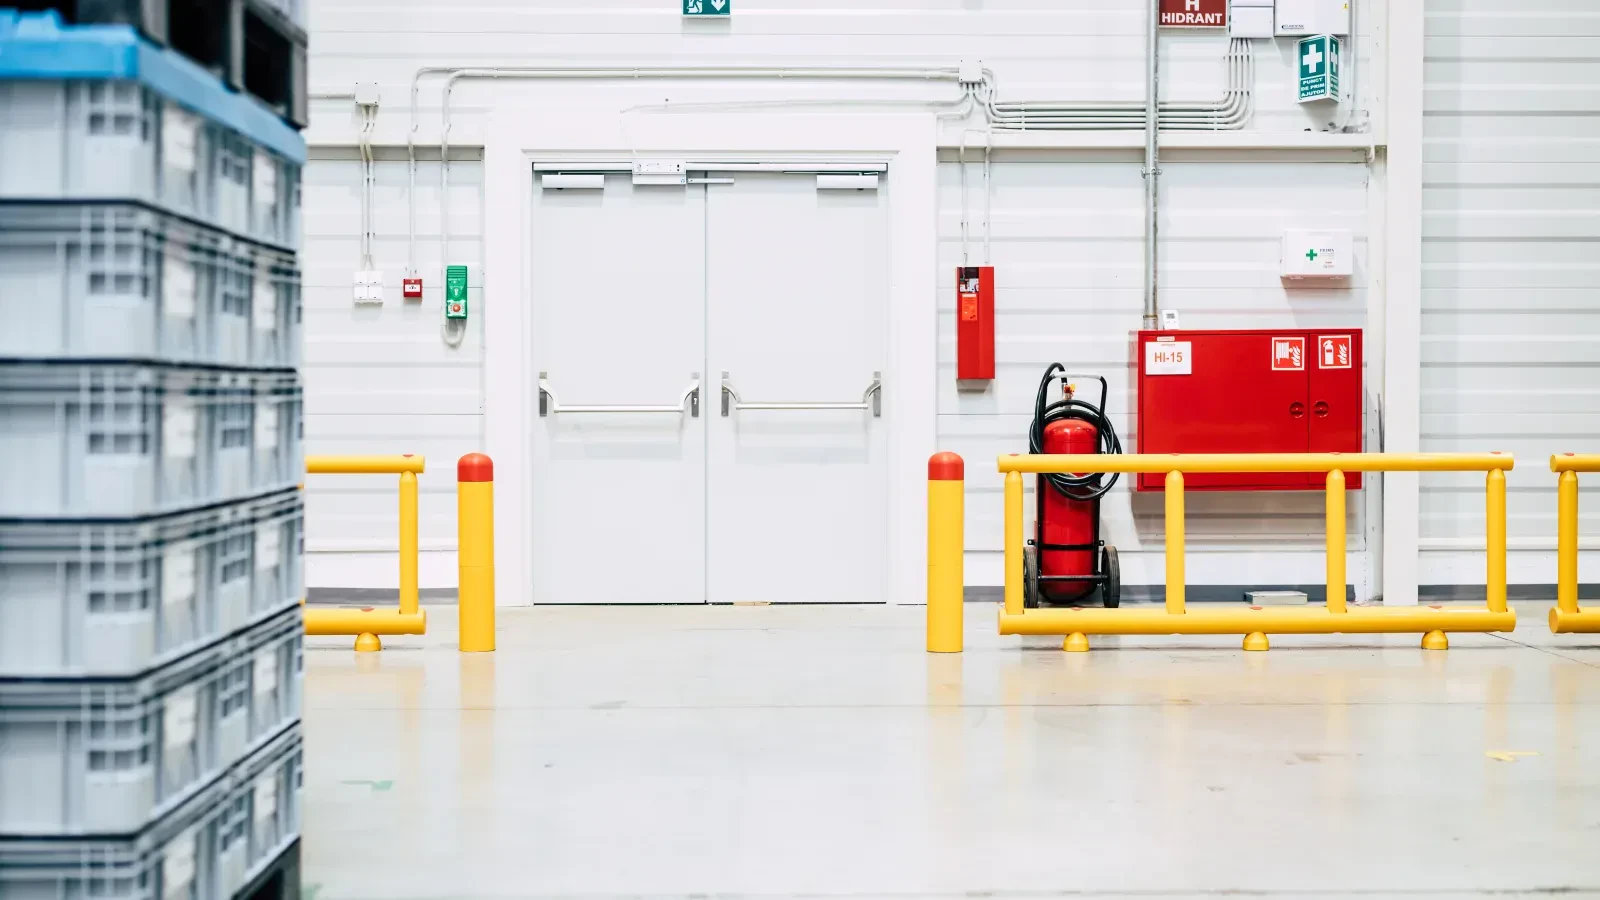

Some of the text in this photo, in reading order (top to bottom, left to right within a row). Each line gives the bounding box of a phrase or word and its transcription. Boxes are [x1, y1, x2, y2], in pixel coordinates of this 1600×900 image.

[1185, 0, 1200, 11] H
[1161, 12, 1223, 24] HIDRANT
[1302, 77, 1323, 85] PUNCT
[1310, 82, 1325, 90] PRIM
[1301, 88, 1325, 97] AJUTOR
[1154, 351, 1183, 363] HI-15
